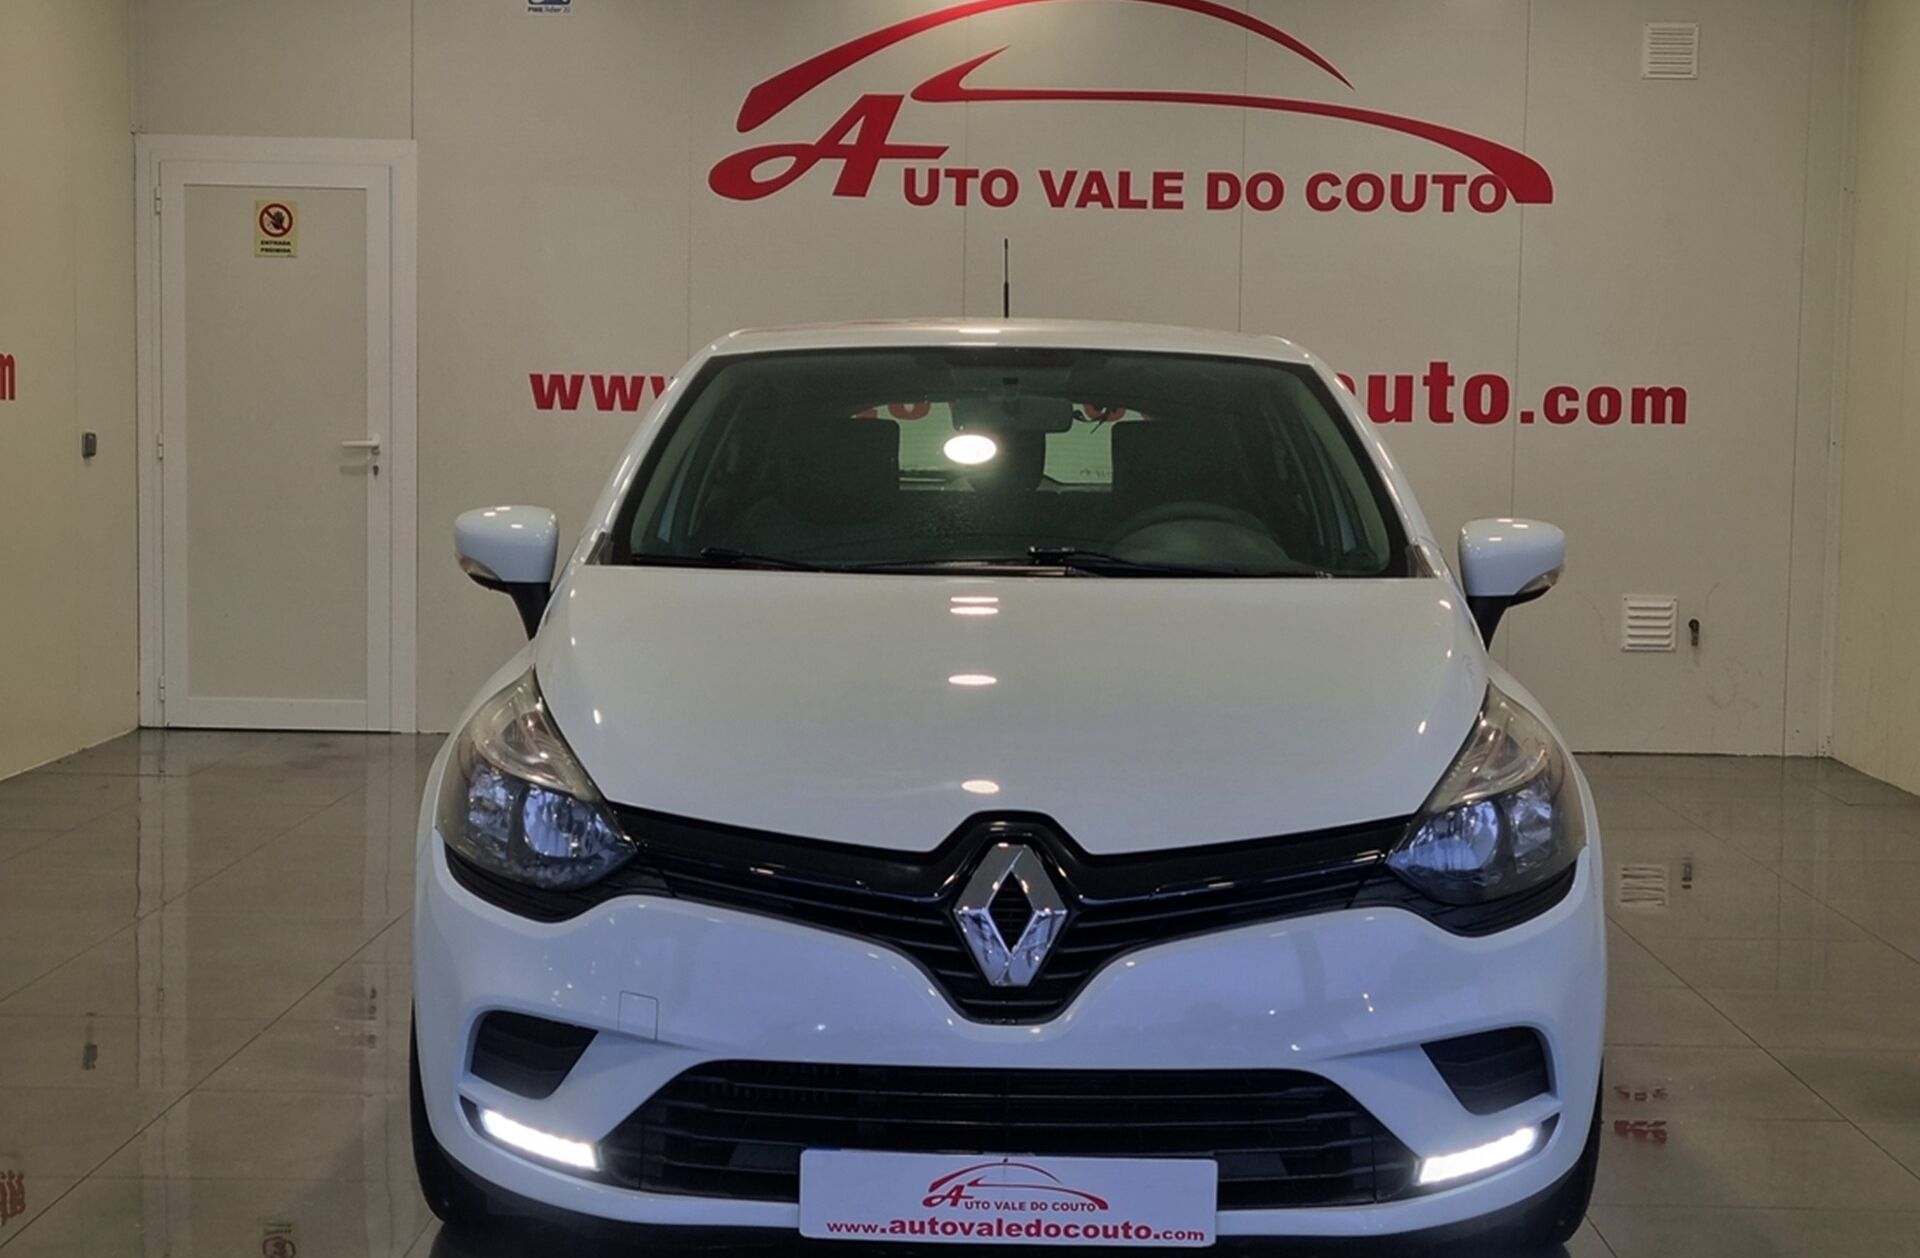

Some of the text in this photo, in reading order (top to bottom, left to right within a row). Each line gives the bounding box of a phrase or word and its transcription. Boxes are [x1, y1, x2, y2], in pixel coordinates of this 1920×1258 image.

[709, 94, 1505, 214] AUTO VALE DO COUTO
[995, 1201, 1026, 1211] VALE
[1030, 1202, 1048, 1211] DO
[1052, 1202, 1096, 1212] COUTO
[826, 1216, 1205, 1241] www.autovaledocouto.com
